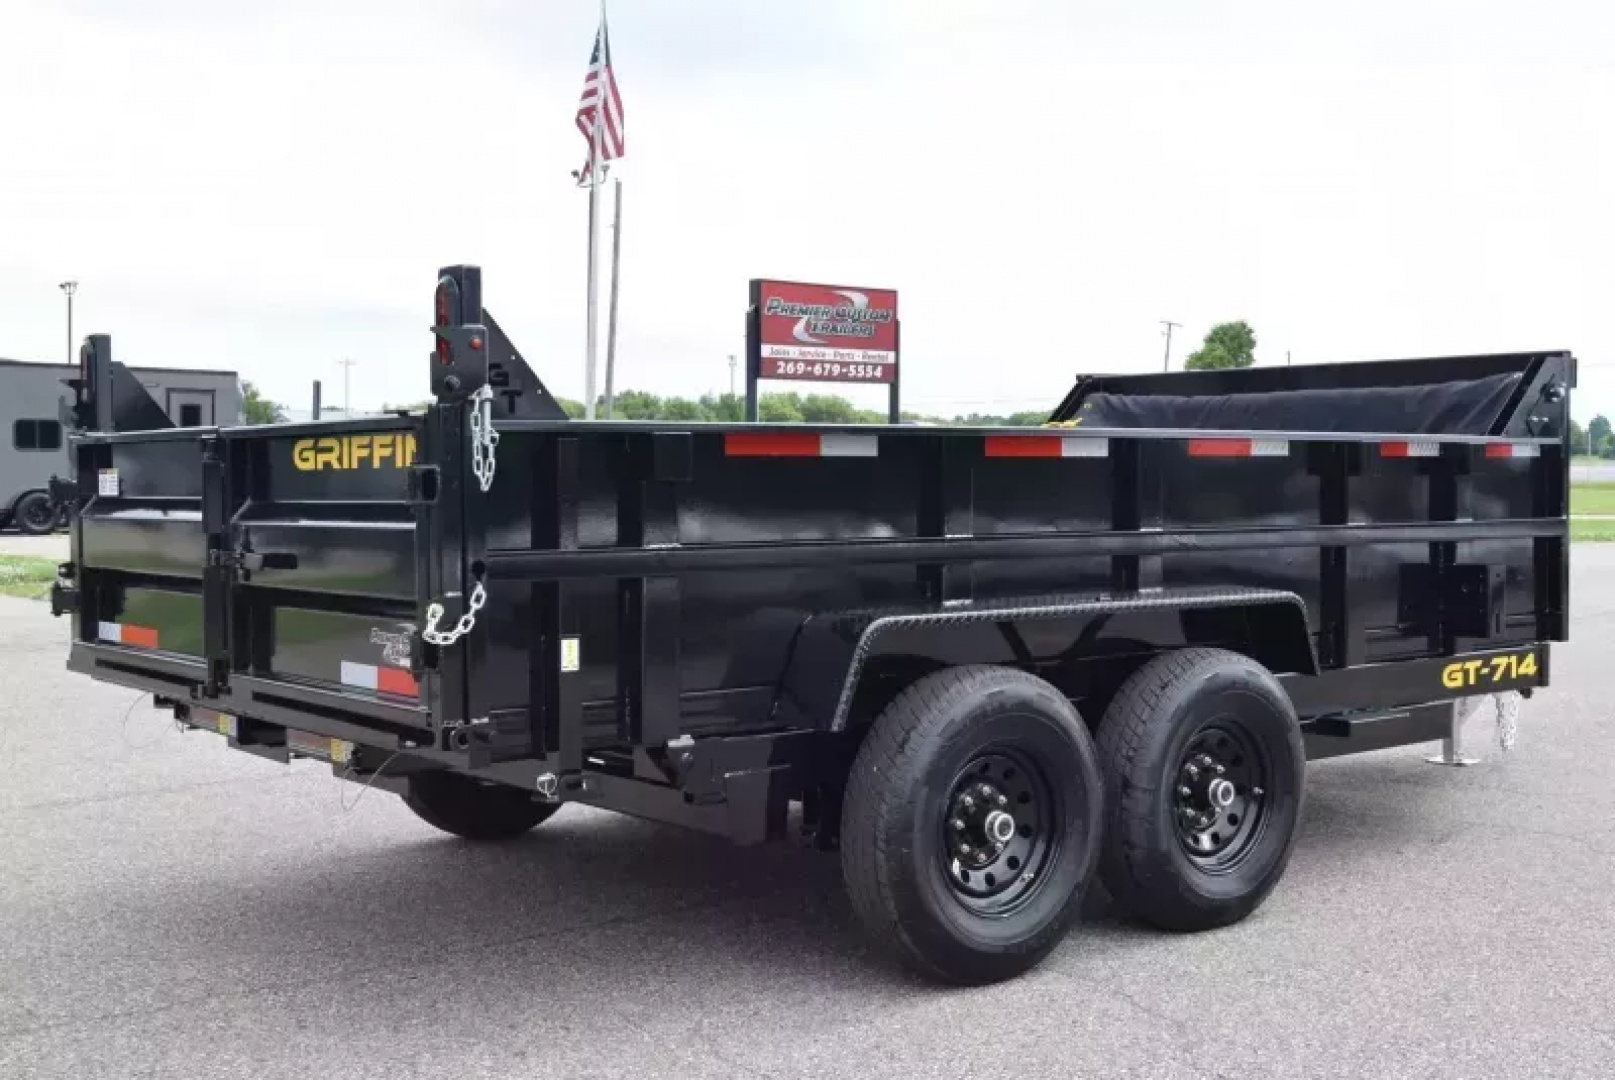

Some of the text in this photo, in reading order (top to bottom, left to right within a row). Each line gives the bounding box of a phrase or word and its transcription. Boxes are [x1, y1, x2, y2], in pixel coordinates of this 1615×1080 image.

[765, 297, 831, 321] PREMIER
[776, 361, 883, 378] 269-679-5554
[1442, 652, 1538, 688] GT-714
